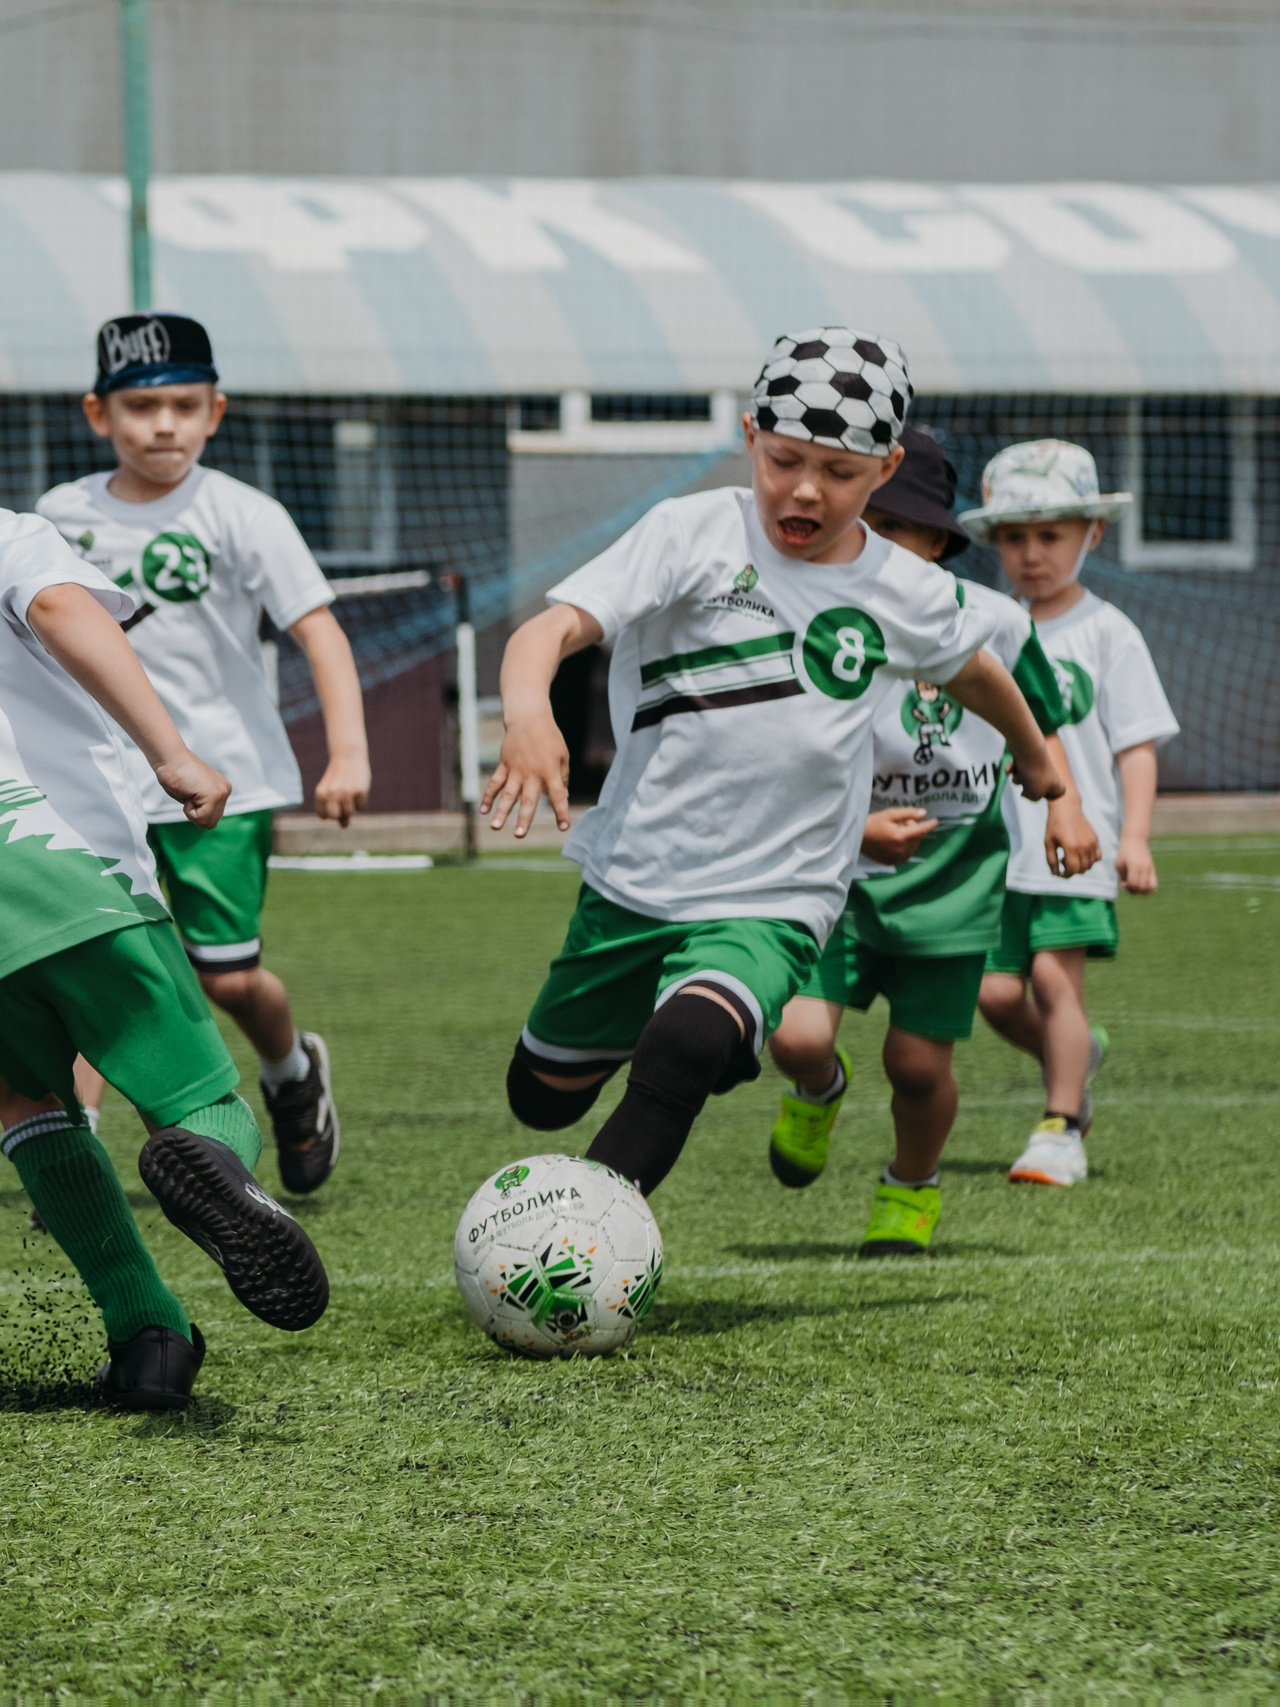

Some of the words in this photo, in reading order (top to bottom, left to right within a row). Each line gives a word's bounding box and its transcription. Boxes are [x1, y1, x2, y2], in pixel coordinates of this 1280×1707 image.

[707, 596, 775, 618] УТБОЛИКА
[831, 626, 866, 682] 8
[468, 1187, 582, 1244] ФУТБОЛИКА
